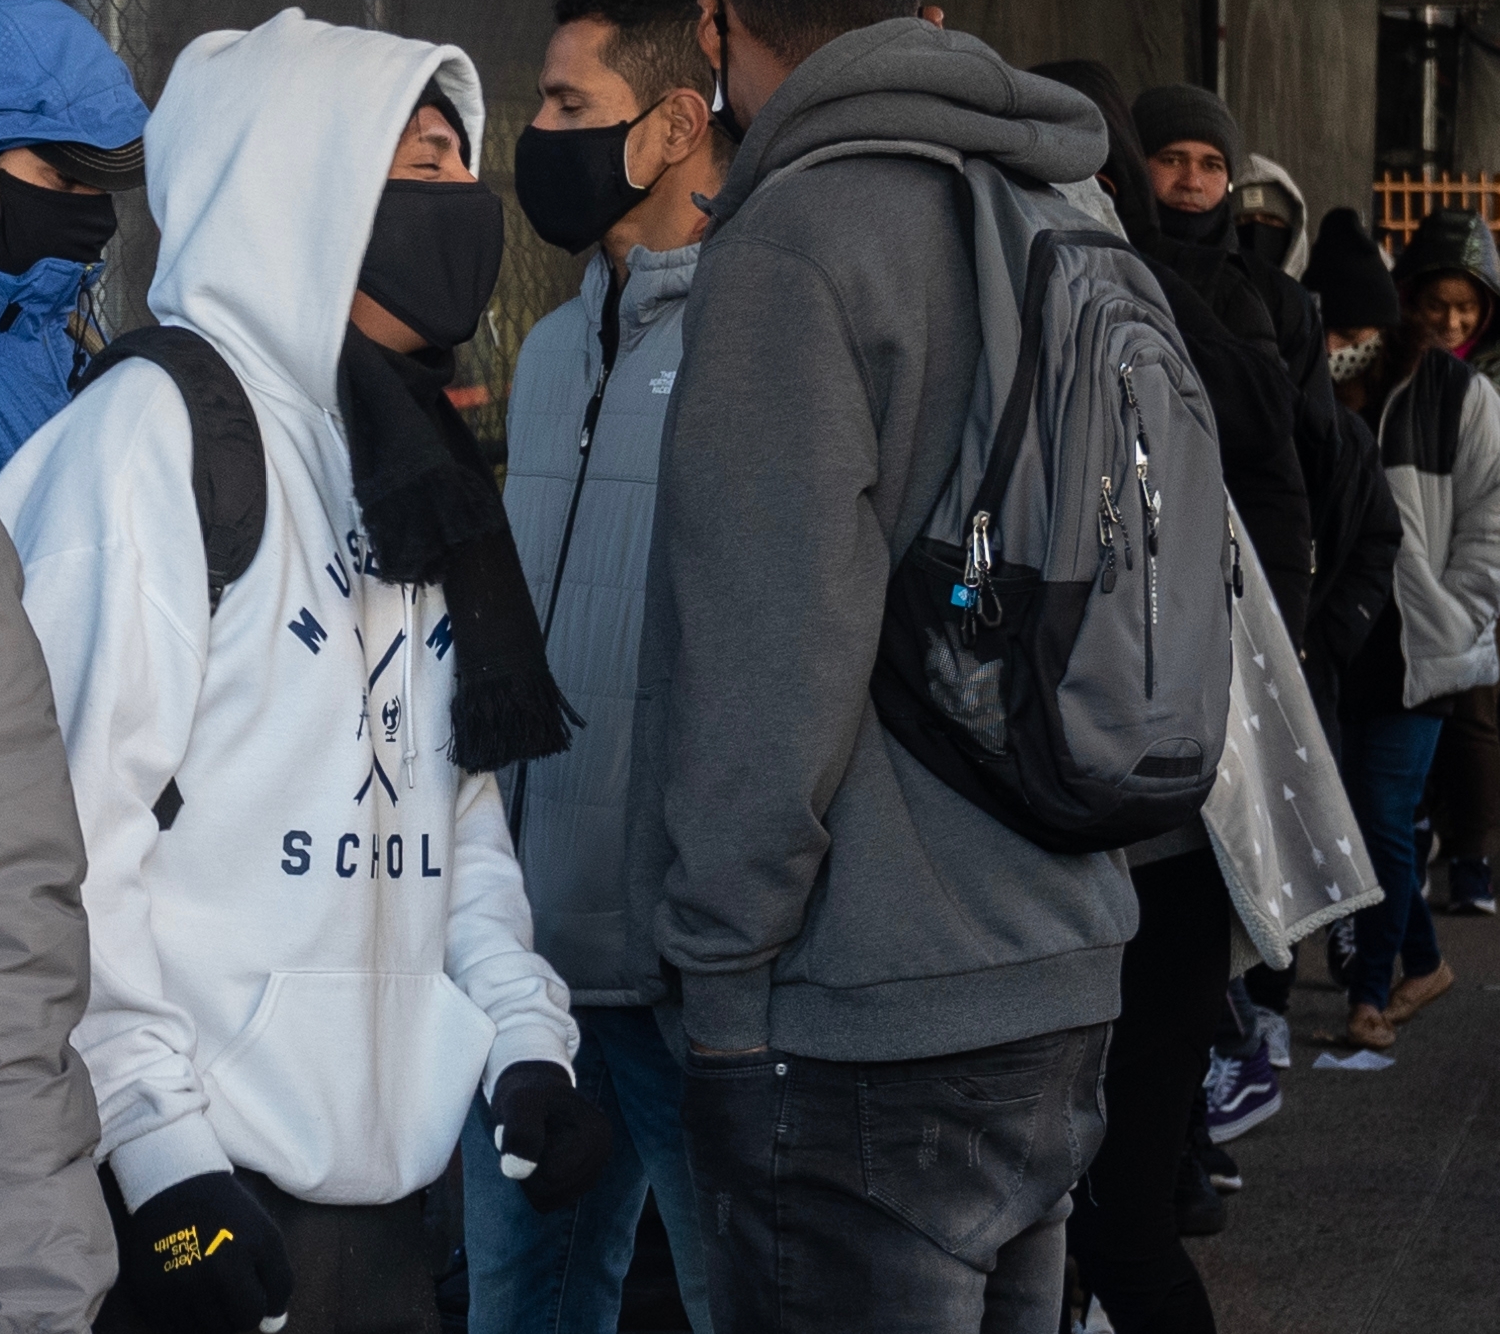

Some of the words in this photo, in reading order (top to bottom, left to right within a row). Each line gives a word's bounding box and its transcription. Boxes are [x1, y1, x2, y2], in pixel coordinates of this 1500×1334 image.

[154, 1225, 197, 1253] Health
[171, 1237, 199, 1256] Plus
[164, 1249, 202, 1272] Metro
